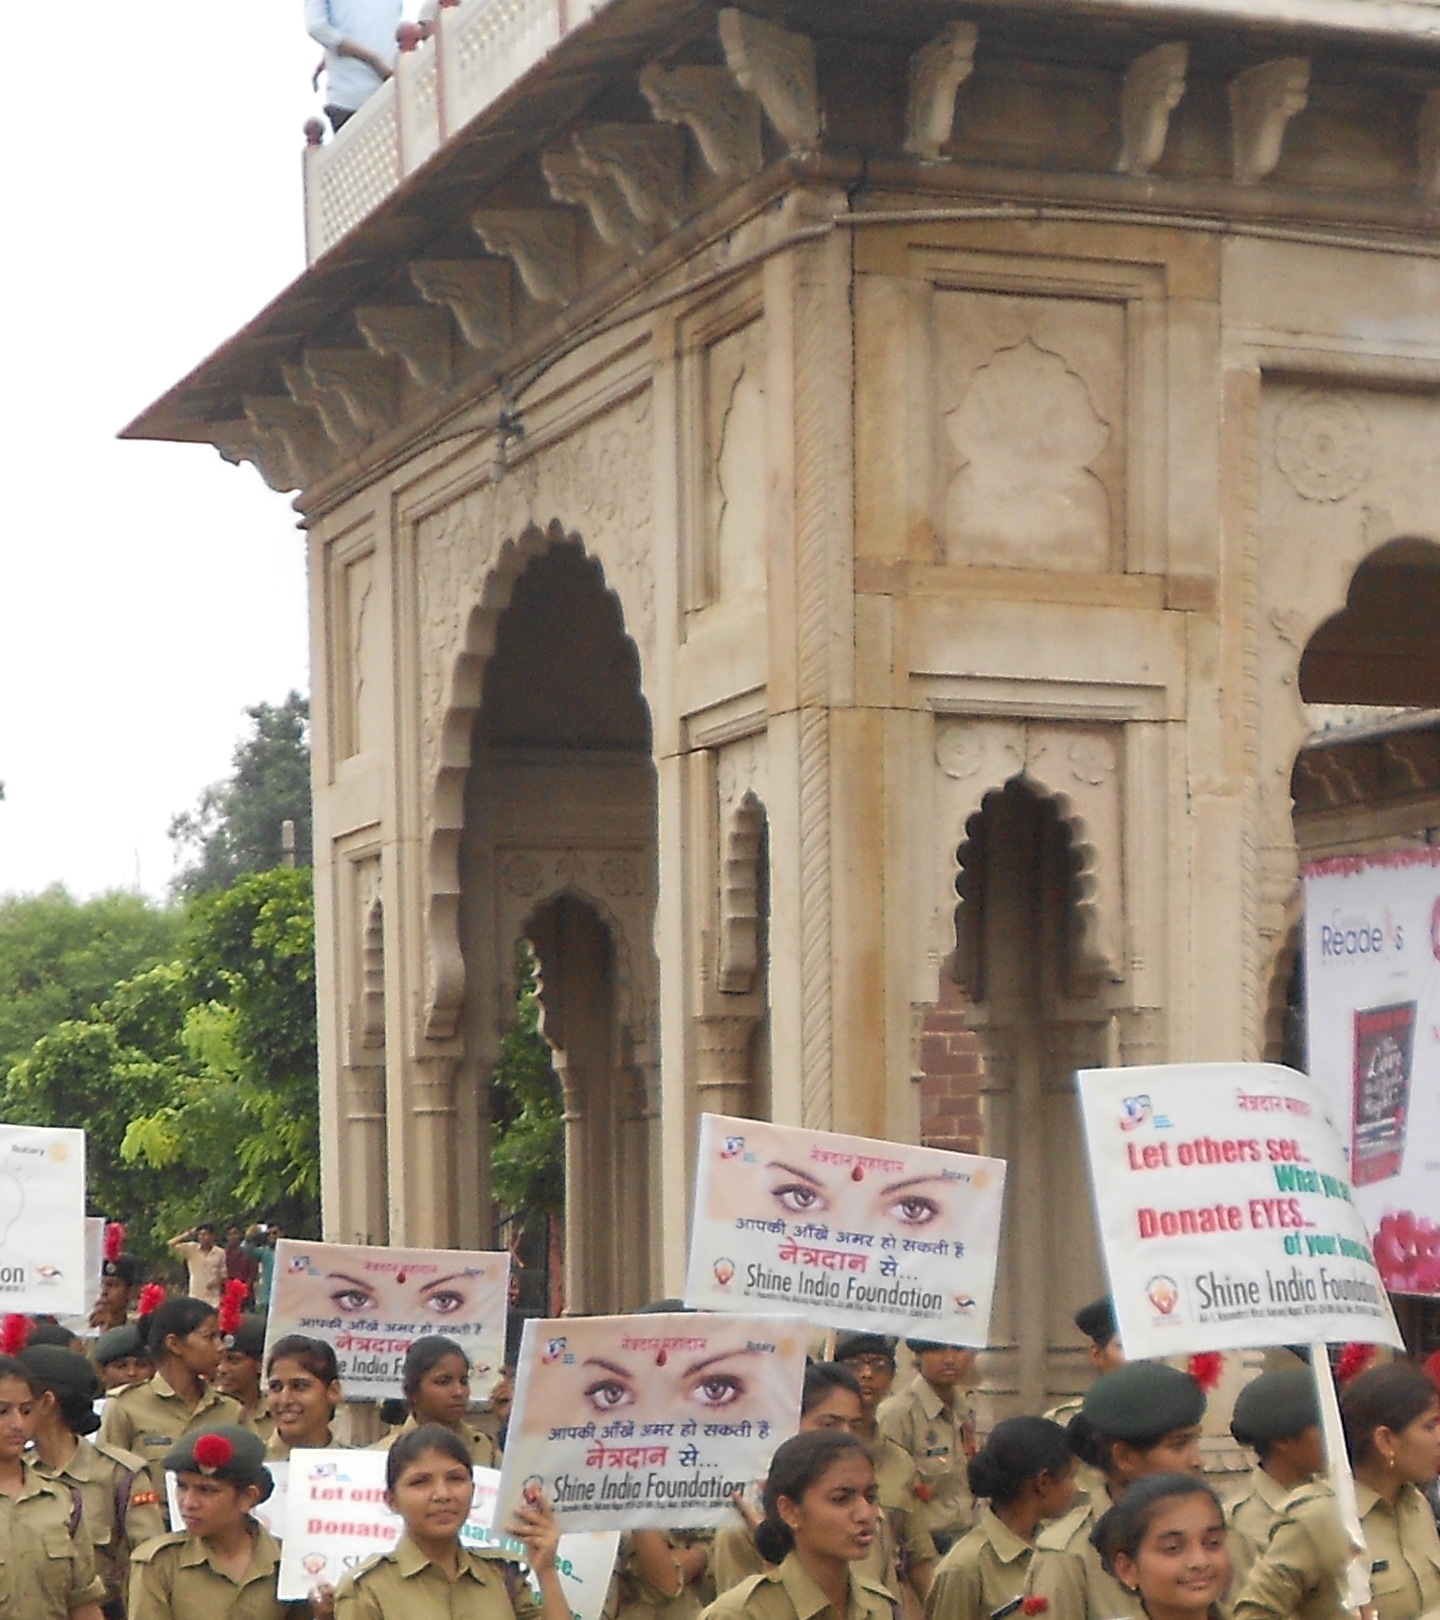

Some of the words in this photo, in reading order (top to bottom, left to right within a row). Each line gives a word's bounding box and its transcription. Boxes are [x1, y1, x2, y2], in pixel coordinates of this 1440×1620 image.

[1126, 1141, 1172, 1171] Let
[1177, 1136, 1261, 1167] others
[736, 1217, 786, 1236] आपकी
[836, 1230, 875, 1248] अमर
[880, 1232, 896, 1250] हो
[901, 1238, 949, 1256] सकती
[1136, 1204, 1244, 1239] Donate
[778, 1236, 869, 1274] नेत्रदान
[1284, 1232, 1304, 1256] of
[746, 1263, 792, 1292] Shine
[798, 1270, 841, 1299] India
[846, 1276, 943, 1310] Foundation
[1195, 1271, 1260, 1310] Shine
[1266, 1266, 1315, 1302] India
[298, 1317, 342, 1330] आपकी
[335, 1330, 413, 1355] नेत्रदान
[351, 1355, 389, 1375] India
[548, 1421, 597, 1441] आपकी
[640, 1423, 674, 1438] अमर
[679, 1418, 698, 1438] हो
[703, 1419, 752, 1438] सकती
[585, 1439, 670, 1471] नेत्रदान
[310, 1486, 345, 1501] Let
[350, 1486, 386, 1501] oth
[553, 1473, 596, 1503] Shine
[600, 1471, 642, 1500] India
[644, 1470, 746, 1499] Foundation
[306, 1518, 397, 1539] Donate
